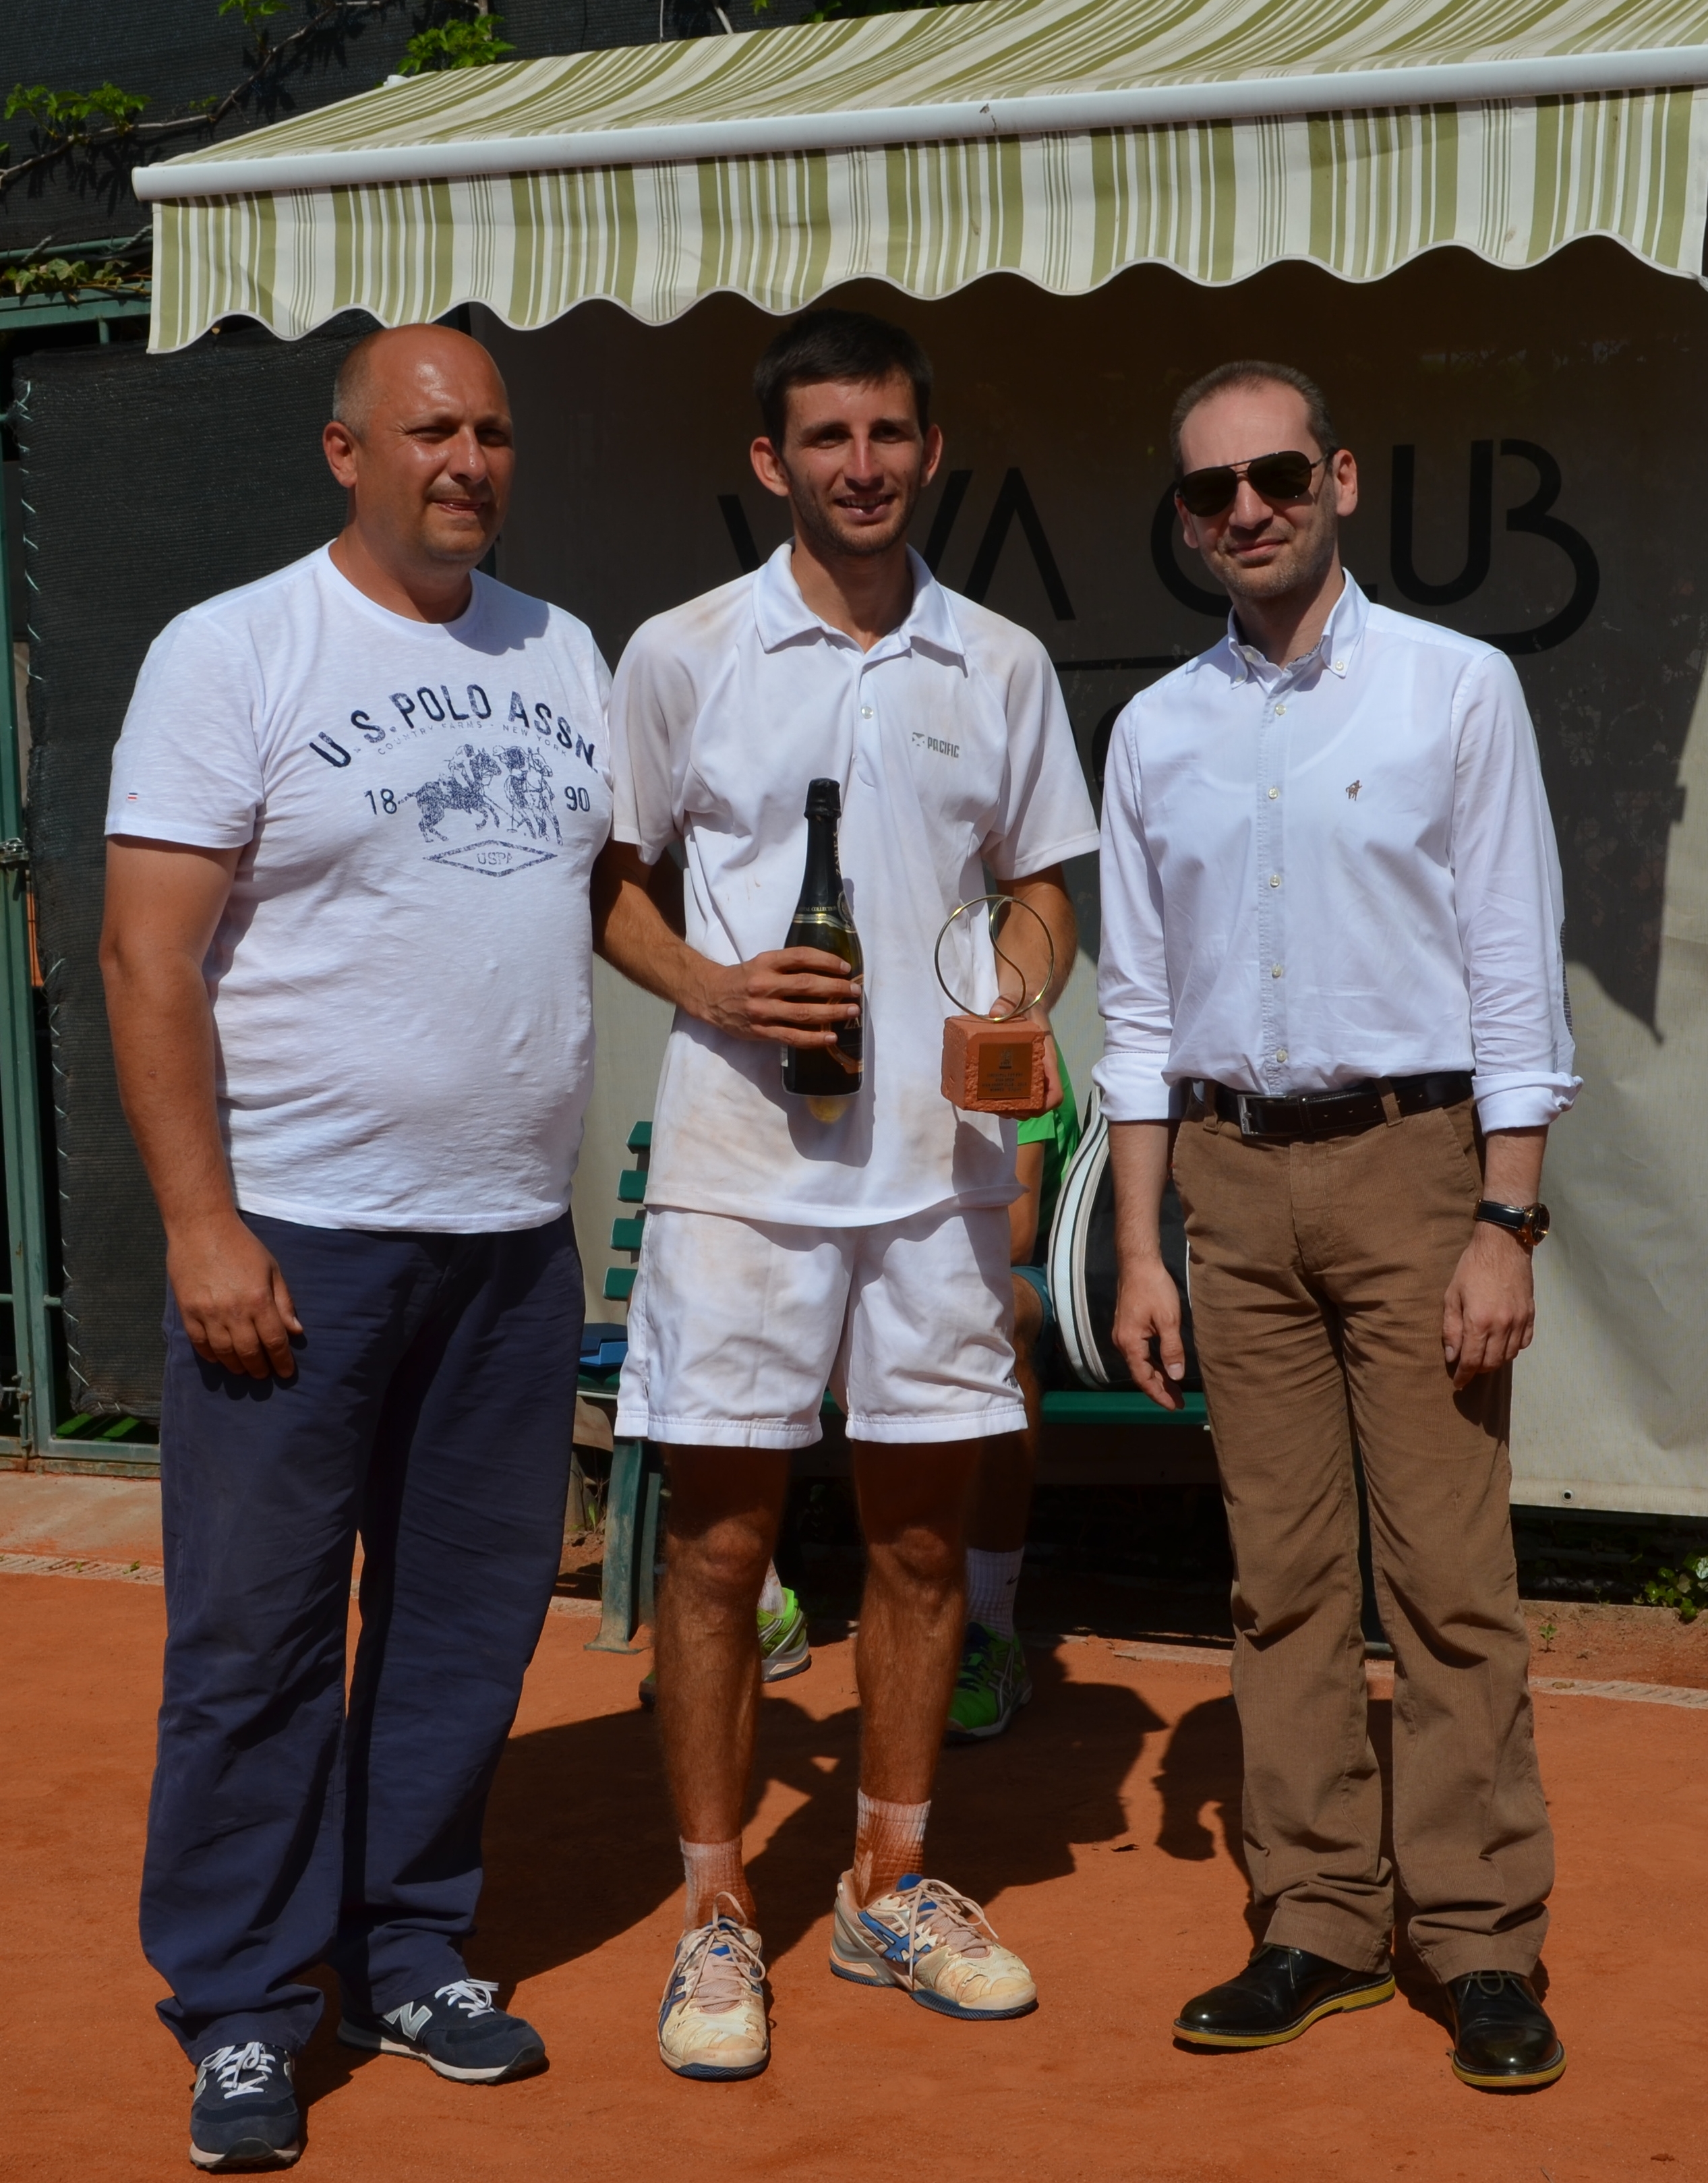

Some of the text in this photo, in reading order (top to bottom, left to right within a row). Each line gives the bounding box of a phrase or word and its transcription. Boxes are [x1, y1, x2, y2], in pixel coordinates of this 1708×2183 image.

[388, 684, 492, 730] POLO
[502, 724, 529, 736] NEW
[537, 735, 568, 757] YORK
[927, 736, 960, 759] PACIFIC
[365, 786, 591, 815] 18 90
